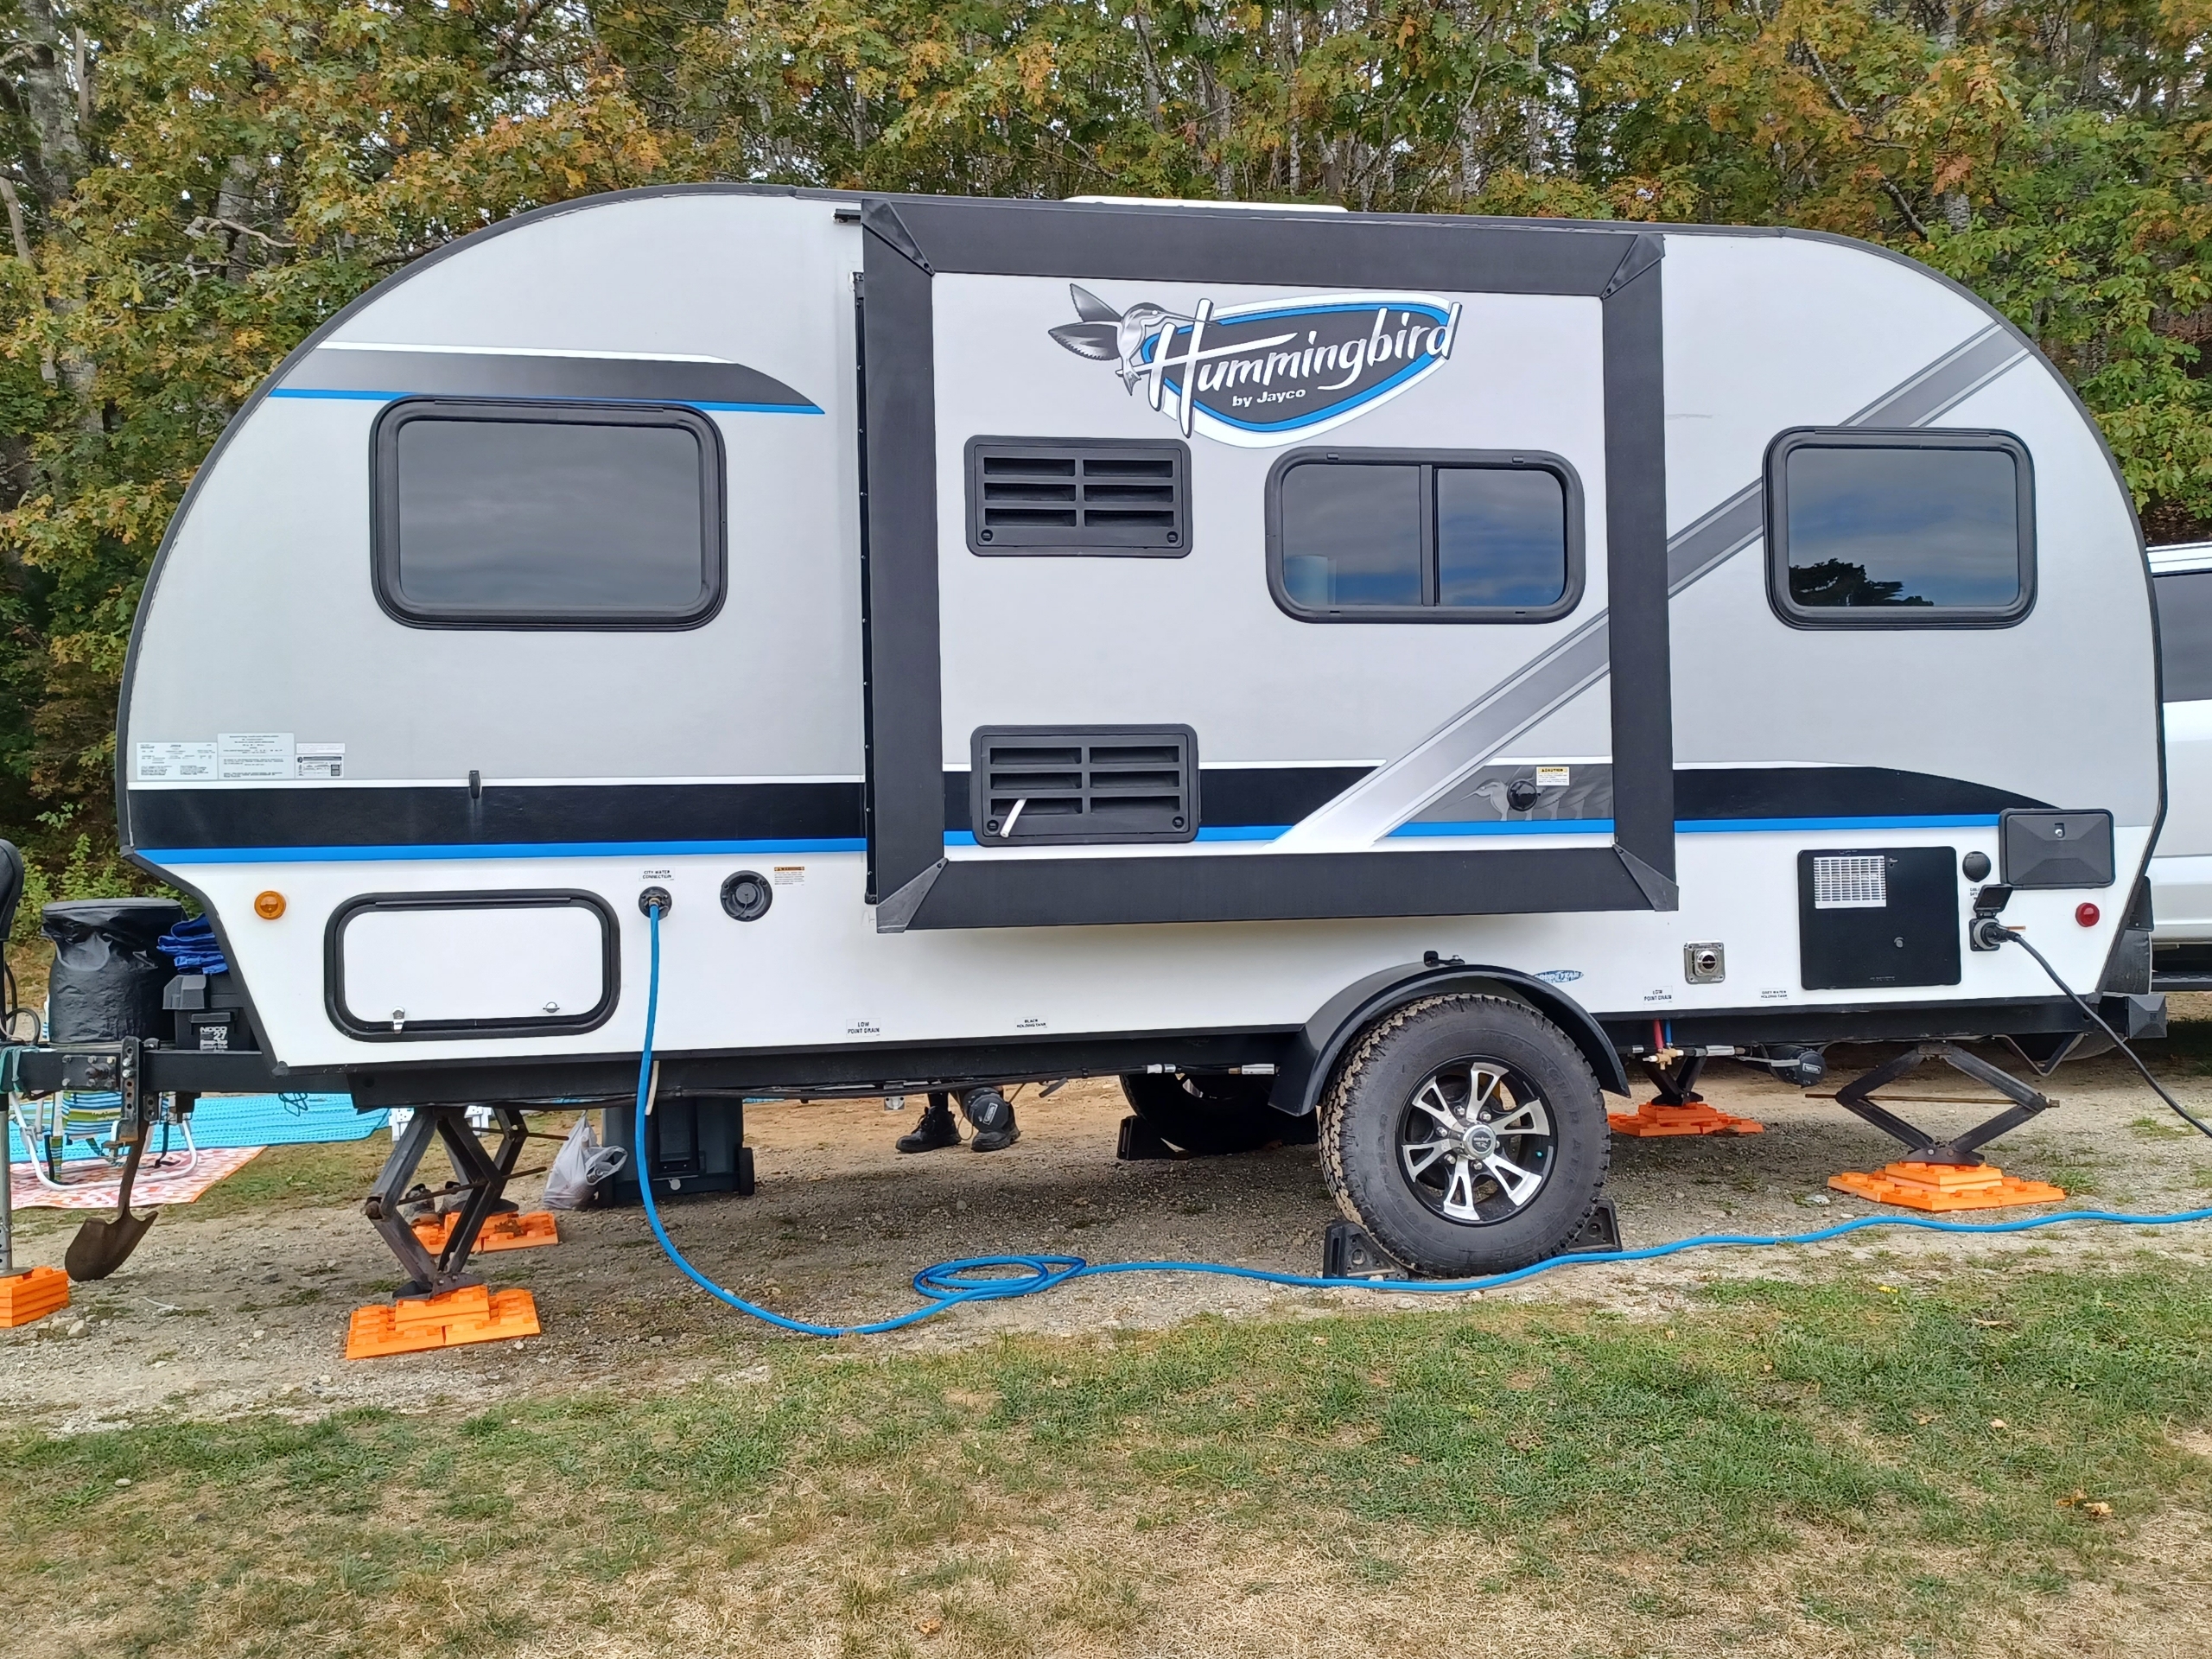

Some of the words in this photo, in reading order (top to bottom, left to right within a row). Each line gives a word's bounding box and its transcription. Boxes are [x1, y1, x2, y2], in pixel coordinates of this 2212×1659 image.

[1116, 298, 1462, 439] Hummingbird
[1232, 396, 1253, 407] by
[1256, 389, 1306, 403] Jayco
